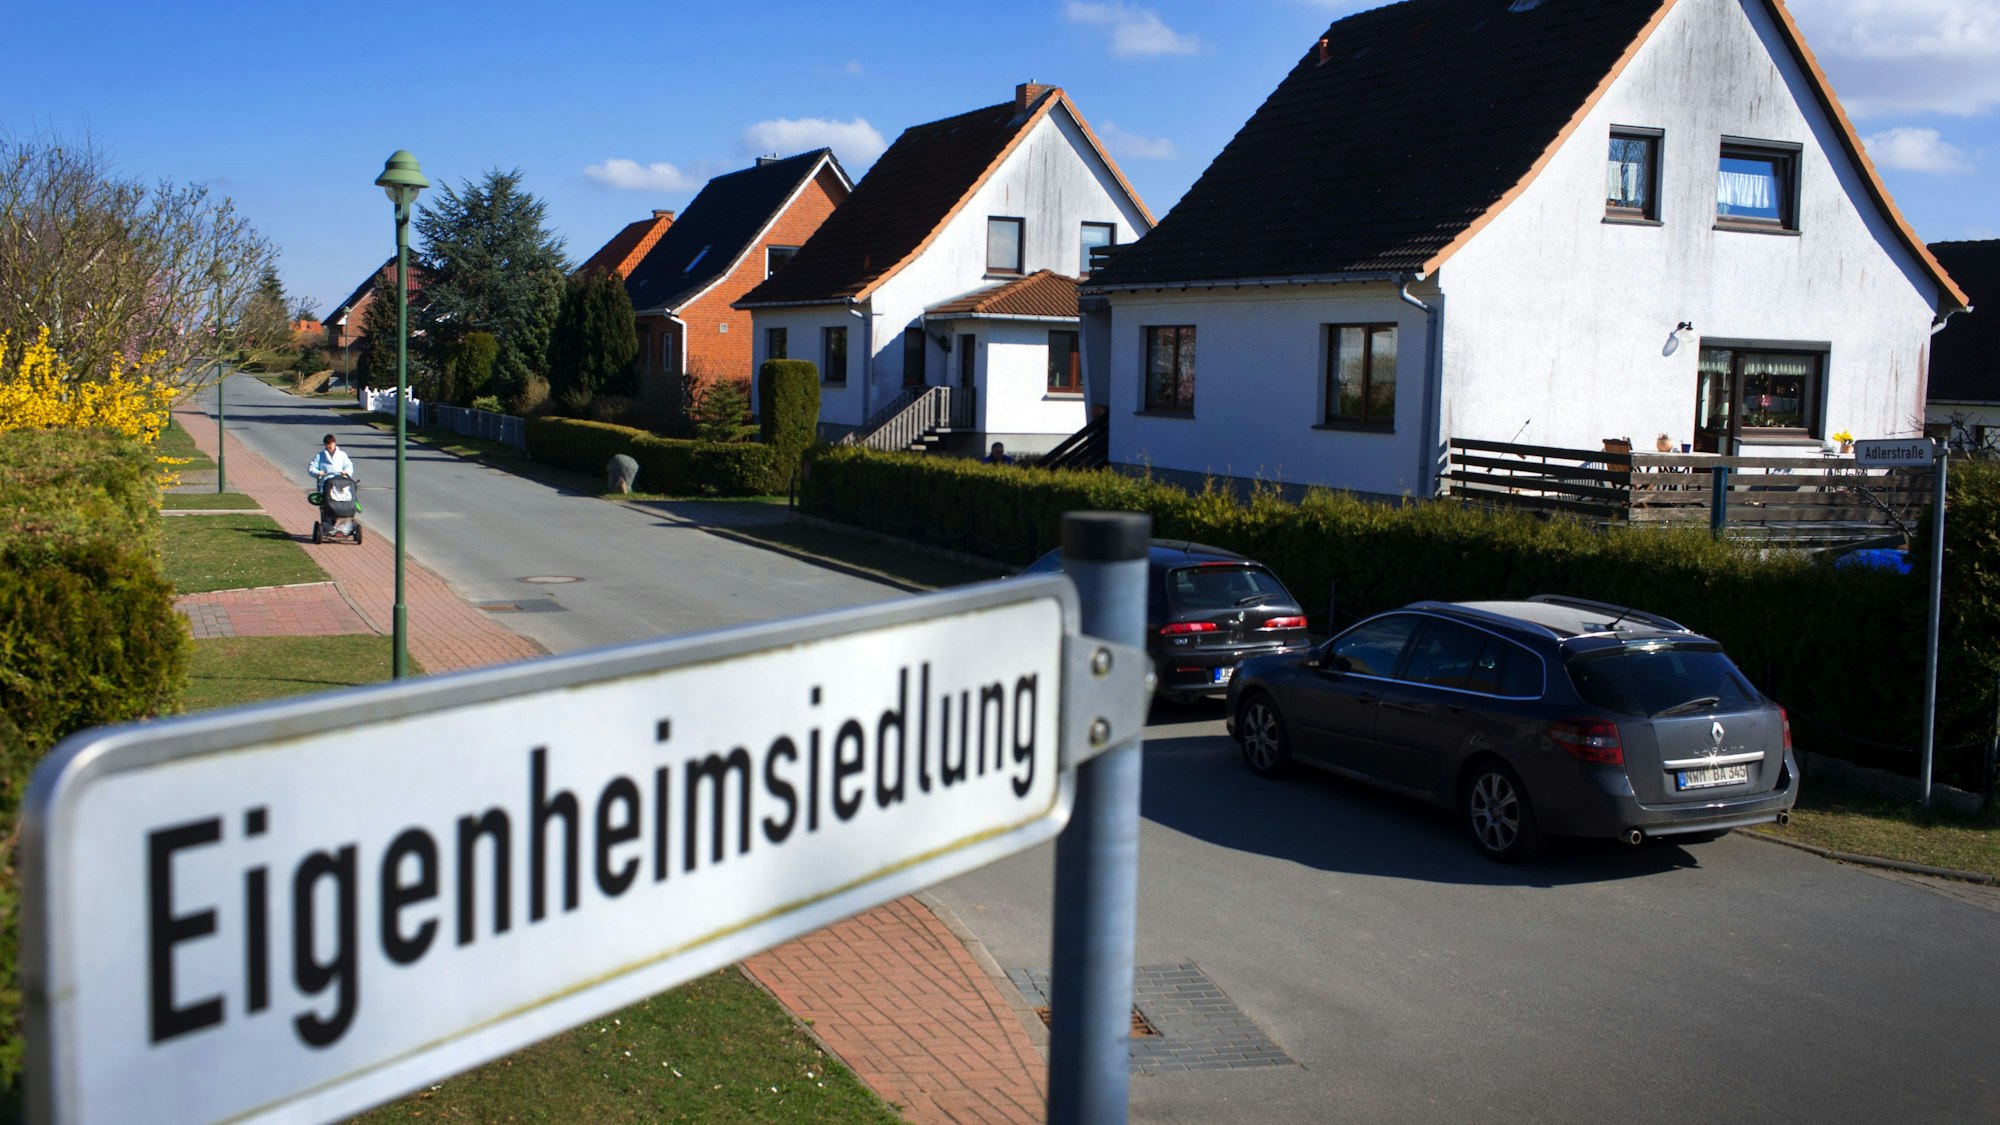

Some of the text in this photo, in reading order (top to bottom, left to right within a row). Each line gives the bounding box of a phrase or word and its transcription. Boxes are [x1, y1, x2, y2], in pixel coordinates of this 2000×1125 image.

[1864, 445, 1924, 460] Adlerstraße
[1693, 745, 1745, 755] LAGUNA
[1686, 765, 1746, 784] NWM BA 345
[146, 659, 1040, 1050] Eigenheimsiedlung
